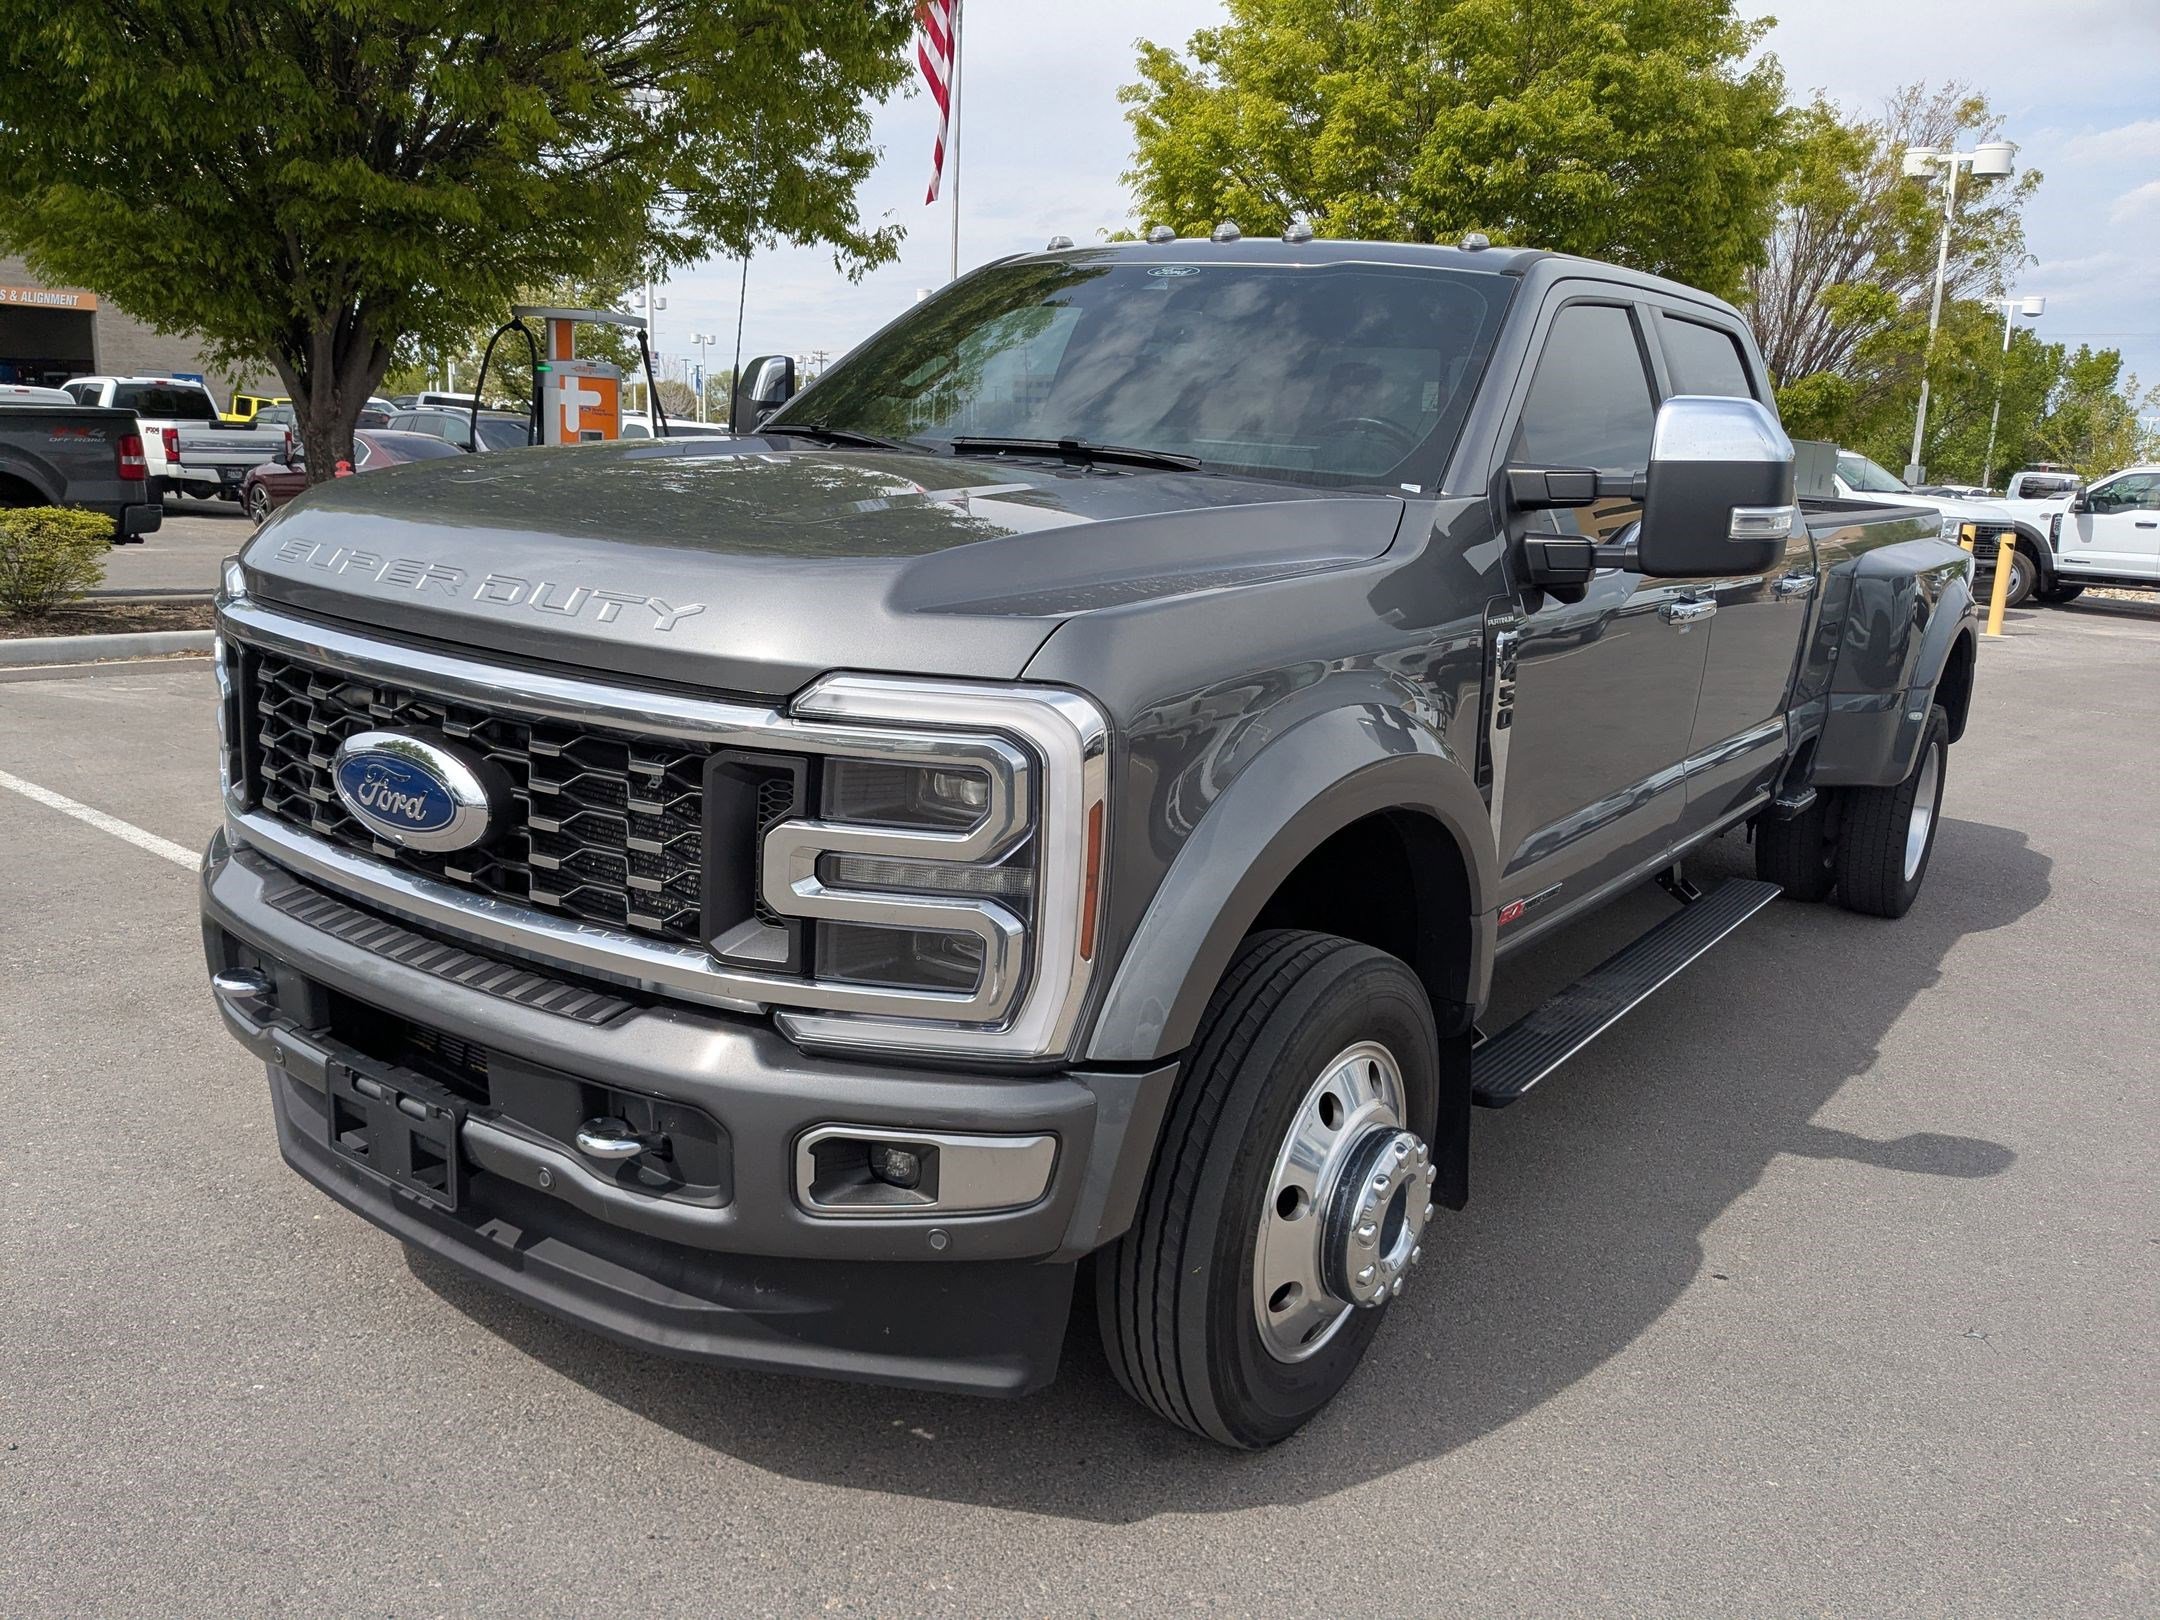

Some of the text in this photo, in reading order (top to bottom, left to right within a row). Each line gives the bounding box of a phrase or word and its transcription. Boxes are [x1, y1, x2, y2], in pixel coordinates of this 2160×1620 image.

[9, 290, 18, 302] &
[21, 291, 79, 306] ALIGNMENT
[275, 536, 706, 632] SUPER DUTY
[358, 763, 433, 821] Ford
